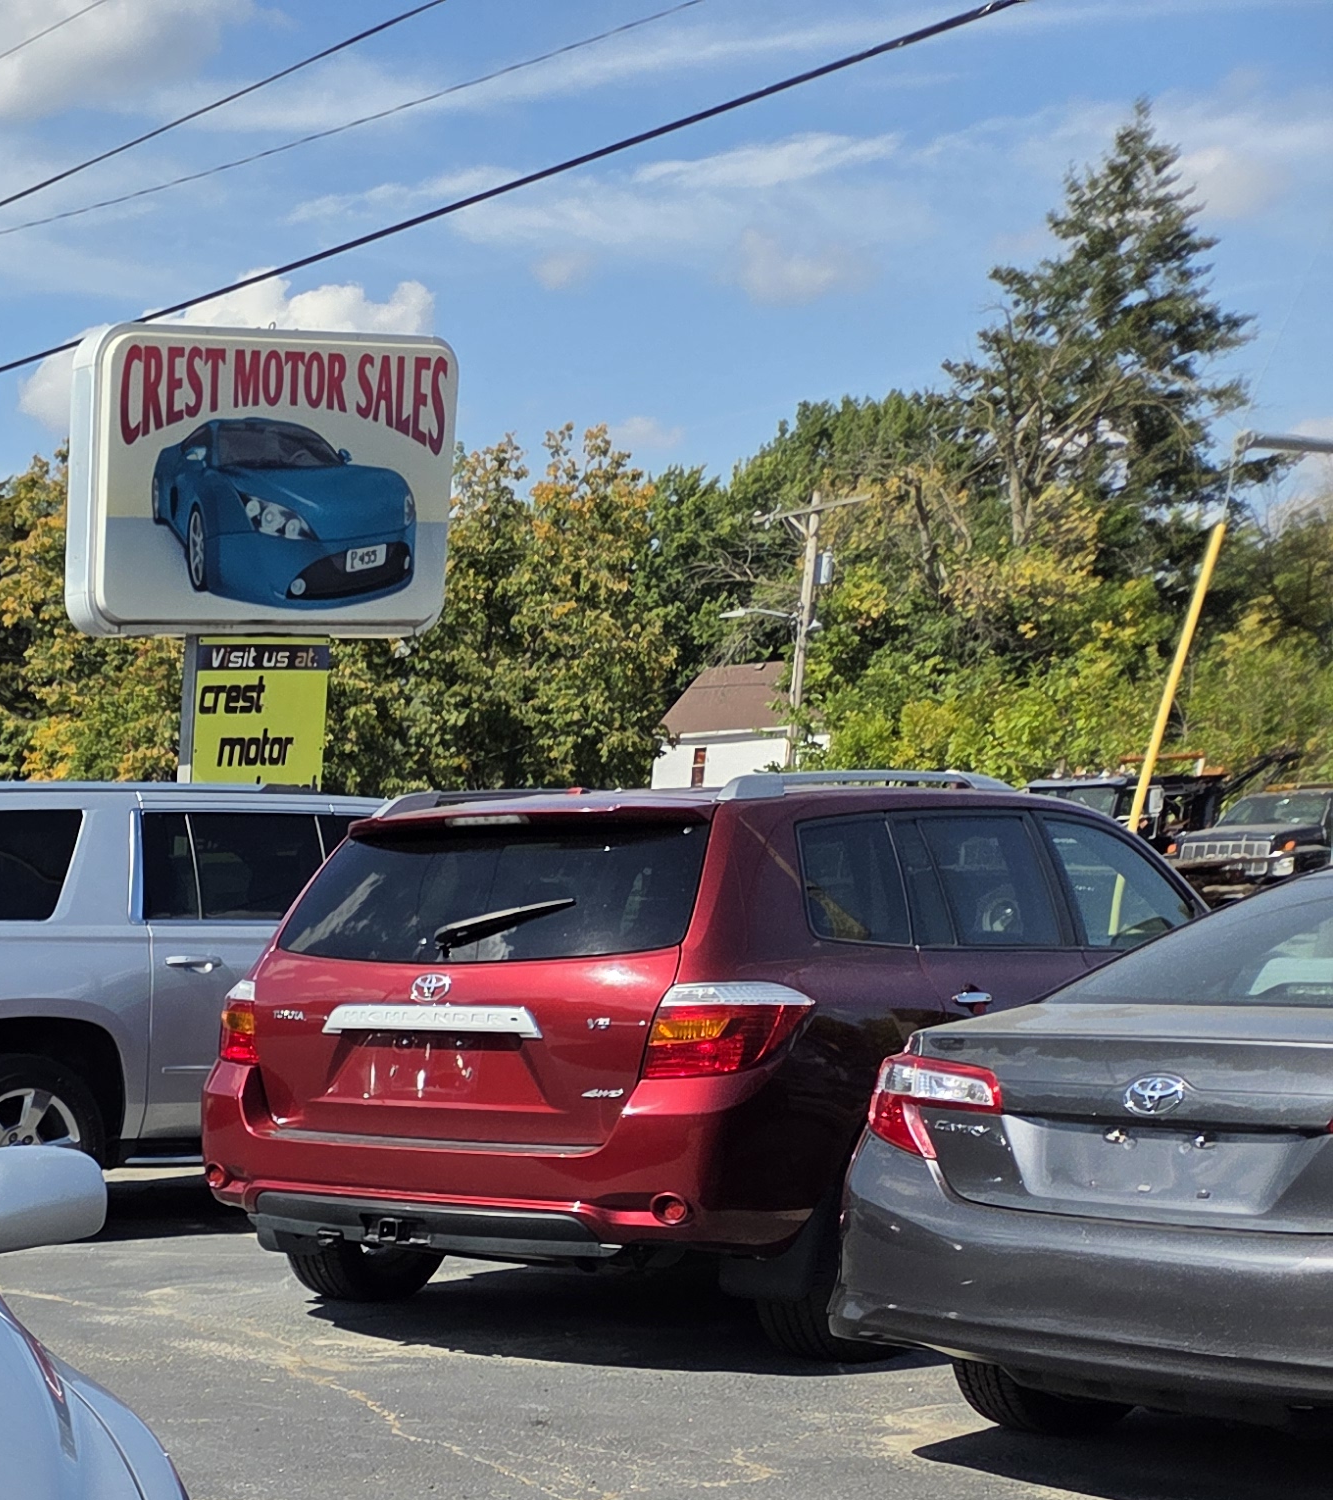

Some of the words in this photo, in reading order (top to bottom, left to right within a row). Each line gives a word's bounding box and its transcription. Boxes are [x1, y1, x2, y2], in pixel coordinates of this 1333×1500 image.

[119, 344, 226, 445] CREST
[233, 348, 347, 413] MOTOR
[356, 353, 449, 456] SALES
[211, 646, 257, 668] Visit
[262, 651, 290, 668] us
[294, 647, 318, 668] at:
[198, 675, 266, 714] crest
[216, 728, 295, 767] motor
[343, 1010, 504, 1026] HIGHLANDER
